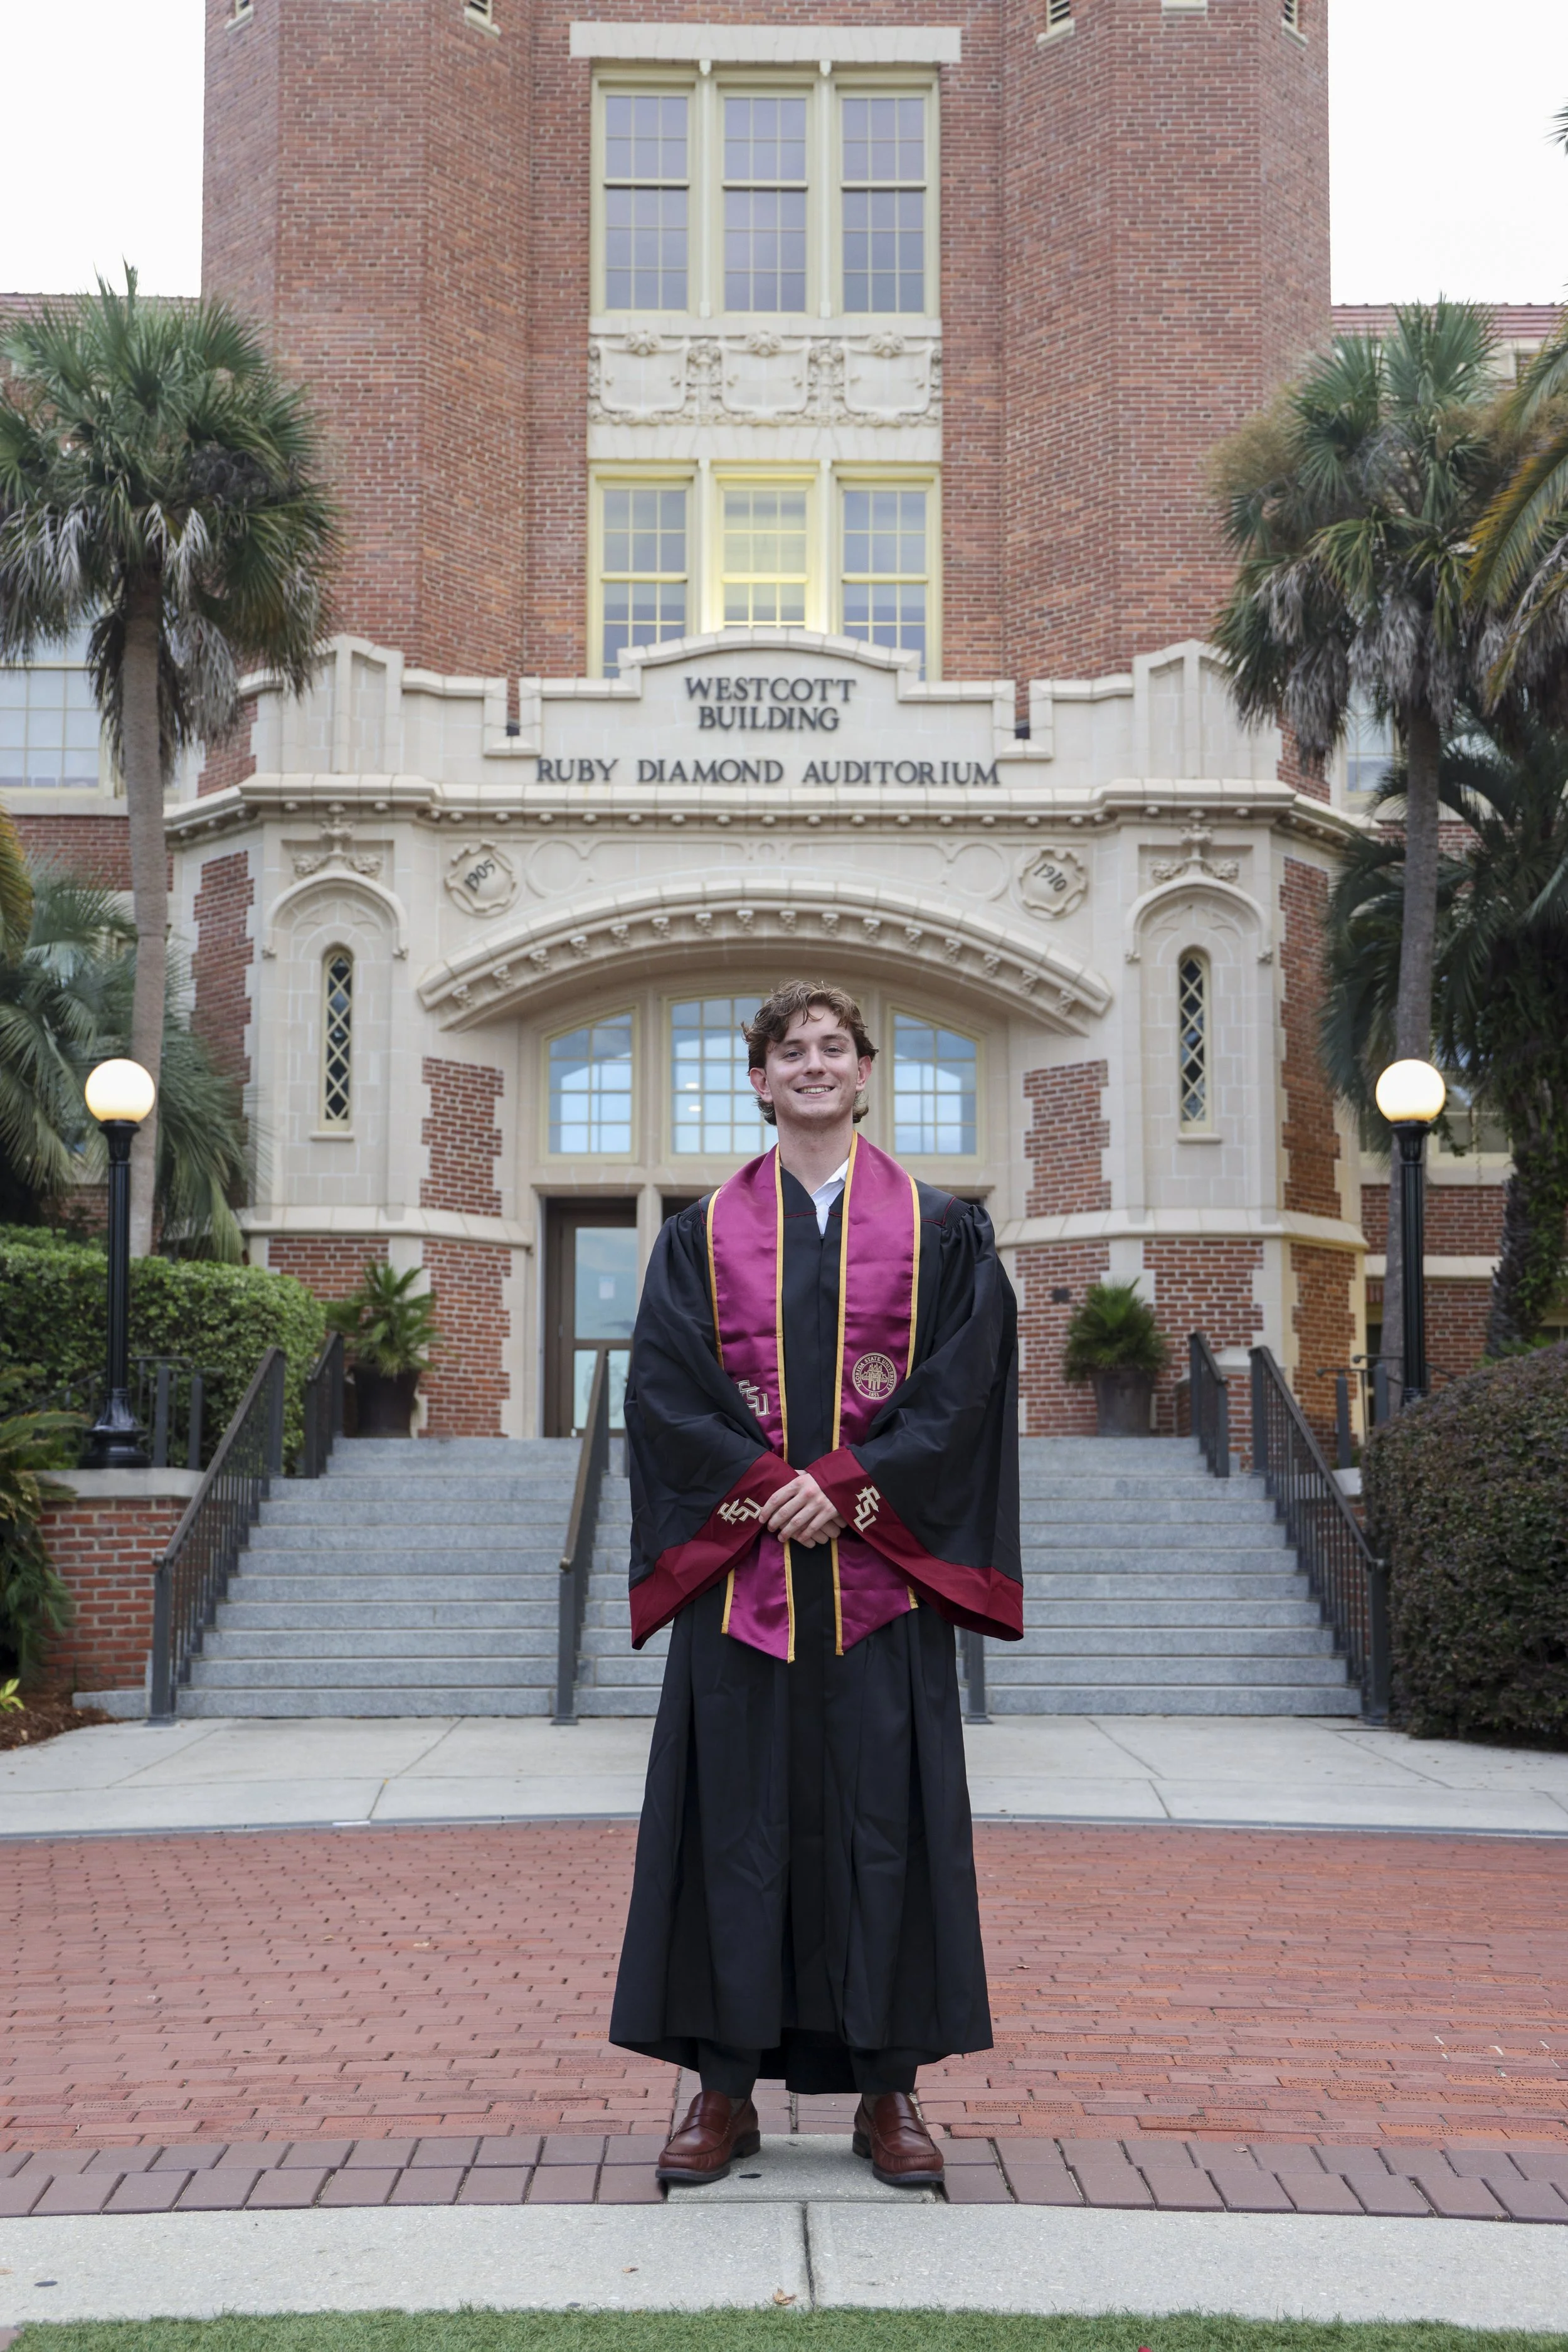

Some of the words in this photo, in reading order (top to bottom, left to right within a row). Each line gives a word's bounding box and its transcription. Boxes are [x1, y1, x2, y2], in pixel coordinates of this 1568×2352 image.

[686, 678, 856, 703] WESTCOTT
[699, 706, 839, 732] BUILDING
[536, 759, 618, 782] RUBY
[638, 759, 783, 784] DIAMOND
[802, 759, 1000, 785] AUDITORIUM
[1033, 863, 1067, 893] 1910
[855, 1362, 865, 1388] FLORIDA
[881, 1359, 894, 1392] UNIVERSITY
[735, 1379, 771, 1417] FSU
[717, 1498, 763, 1525] FSU
[854, 1485, 881, 1532] FSU
